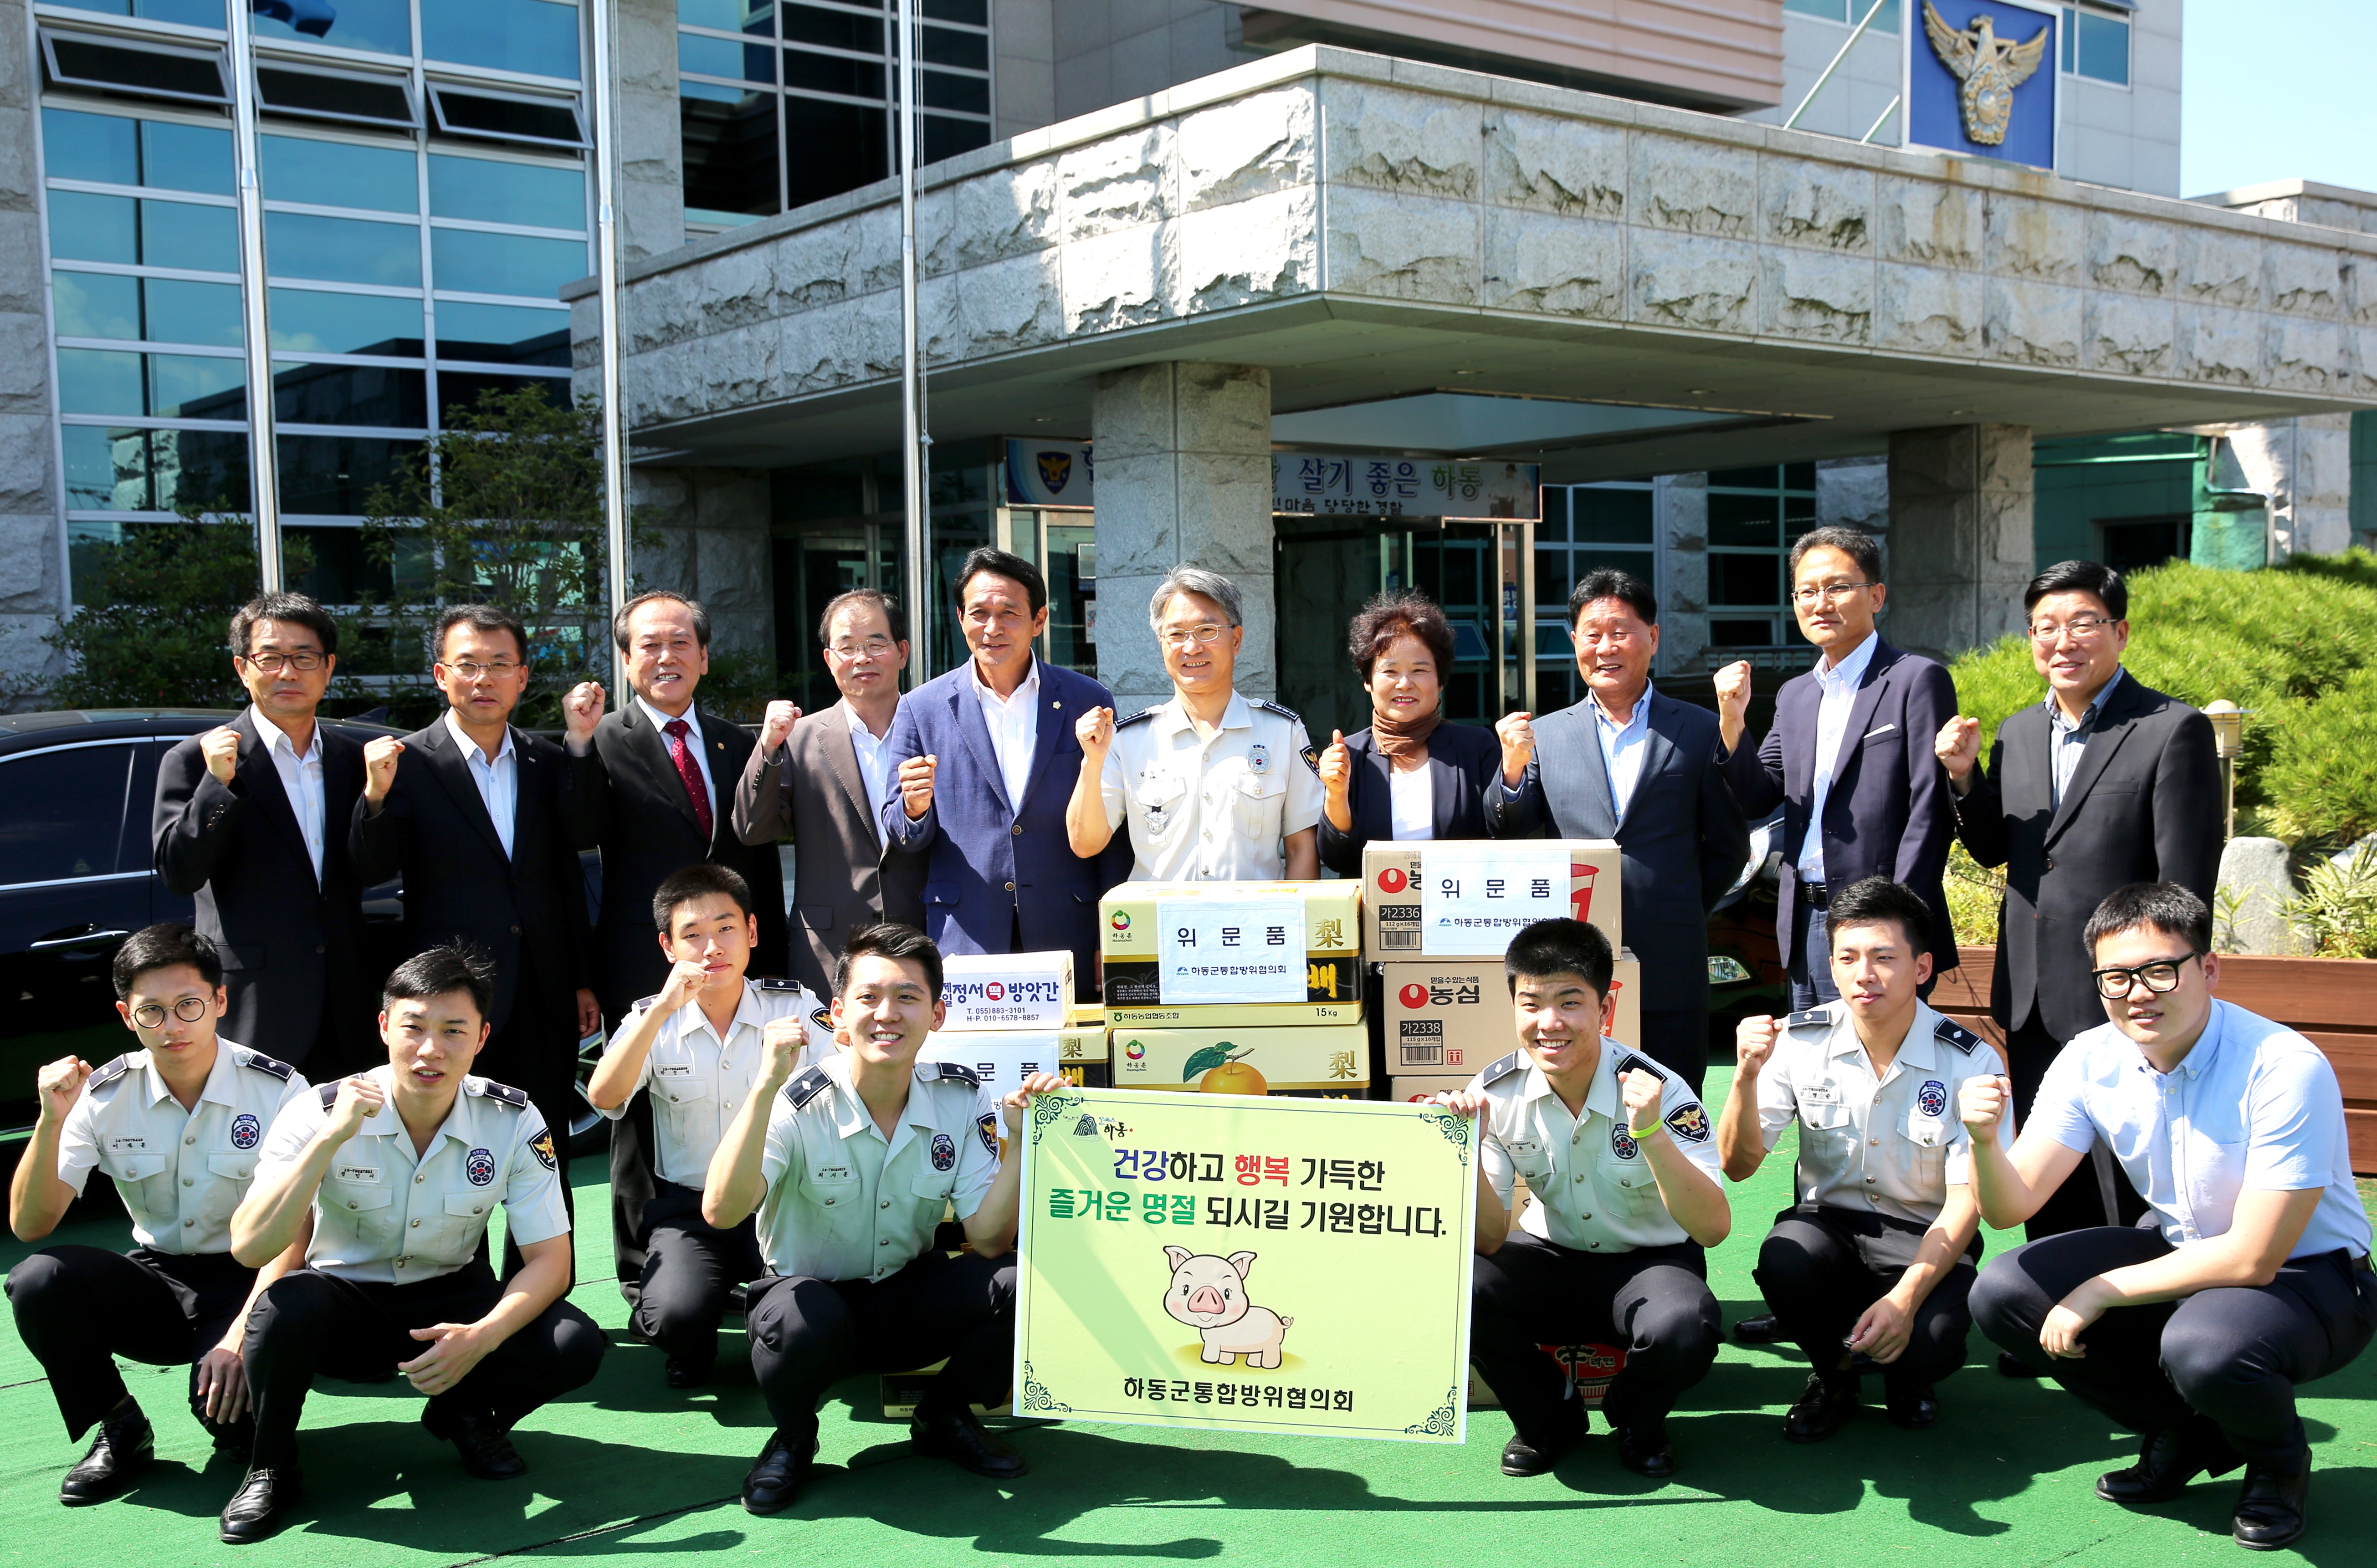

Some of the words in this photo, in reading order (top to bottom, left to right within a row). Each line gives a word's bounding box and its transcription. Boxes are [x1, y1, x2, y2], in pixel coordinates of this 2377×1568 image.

[1298, 457, 1351, 494] 살기
[1366, 461, 1419, 495] 좋은
[1431, 463, 1481, 499] 하동
[1324, 499, 1370, 514] 당당한
[1375, 501, 1403, 515] 경찰
[1381, 907, 1420, 919] 가2336
[1315, 917, 1344, 948] 梨
[1191, 964, 1287, 977] 하동군통합방위협의회
[953, 983, 983, 1004] 정서
[1008, 981, 1059, 1003] 방앗간
[1429, 985, 1480, 1006] 농심
[984, 1014, 1040, 1022] 010-6578-8857
[1123, 1012, 1179, 1020] 하동농업협동조합
[1402, 1022, 1440, 1035] 가2338
[1062, 1037, 1083, 1058] 梨
[1328, 1049, 1357, 1079] 梨
[1104, 1122, 1128, 1141] 하동
[1690, 1127, 1706, 1136] POLICE
[1113, 1149, 1224, 1182] 건강하고
[1235, 1154, 1290, 1187] 행복
[1300, 1158, 1385, 1191] 가득한
[1049, 1188, 1131, 1222] 즐거운
[1142, 1193, 1196, 1225] 명절
[1205, 1196, 1289, 1230] 되시길
[1300, 1201, 1446, 1238] 기원합니다.
[1590, 1356, 1615, 1368] 라면
[1123, 1377, 1353, 1412] 하동군통합방위협의회
